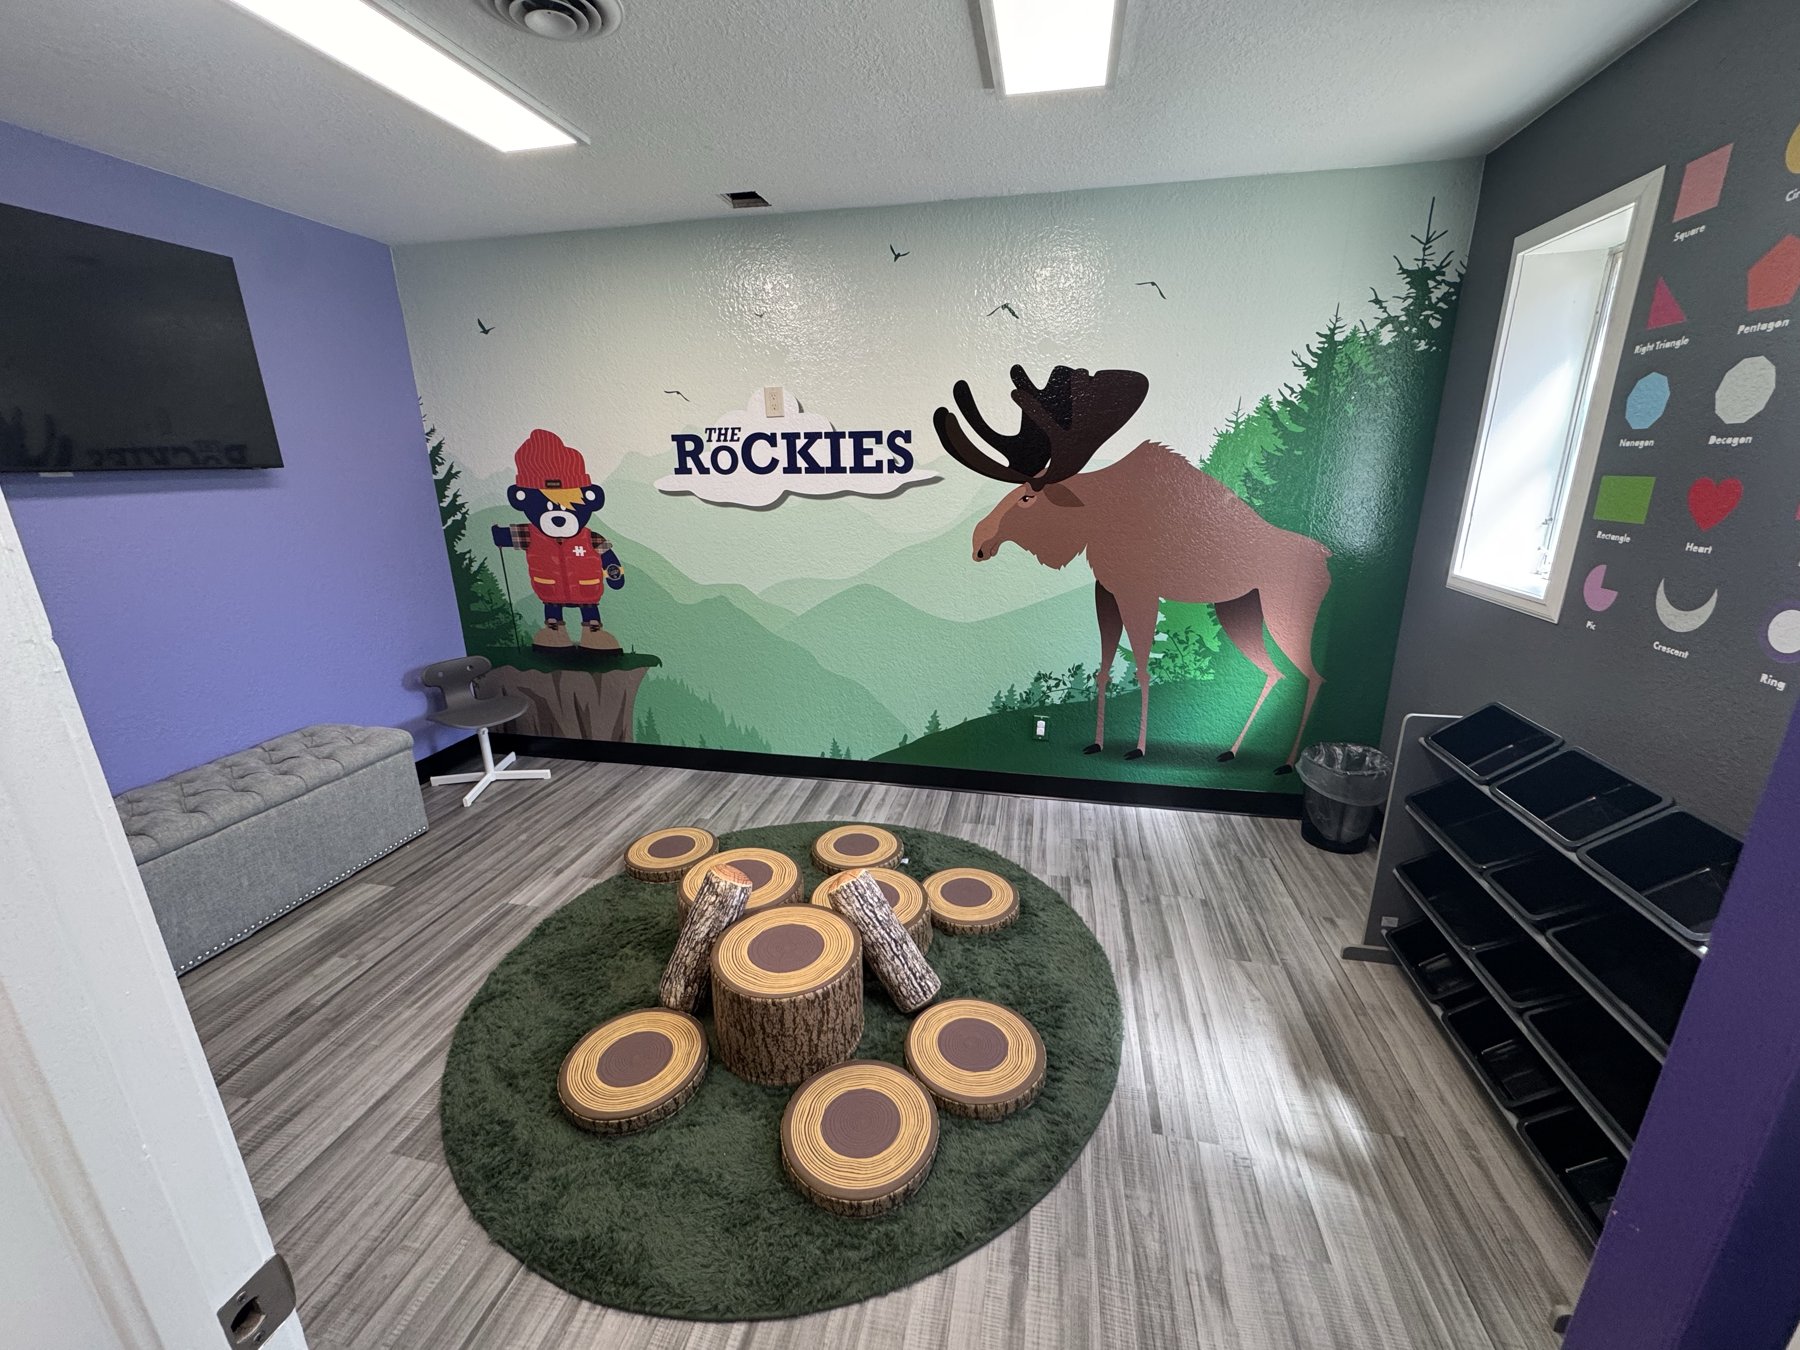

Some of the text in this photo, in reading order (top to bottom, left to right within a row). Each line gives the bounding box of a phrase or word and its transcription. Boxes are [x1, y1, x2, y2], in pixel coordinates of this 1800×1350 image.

[1672, 224, 1706, 242] Square
[1736, 318, 1791, 335] Pentagon
[1633, 335, 1690, 355] Right Triangle
[704, 426, 742, 443] THE
[1707, 435, 1753, 447] Decagon
[1596, 530, 1631, 544] Rectangle
[1684, 542, 1713, 555] Heart
[1652, 641, 1690, 659] Crescent
[1759, 672, 1787, 692] Ring
